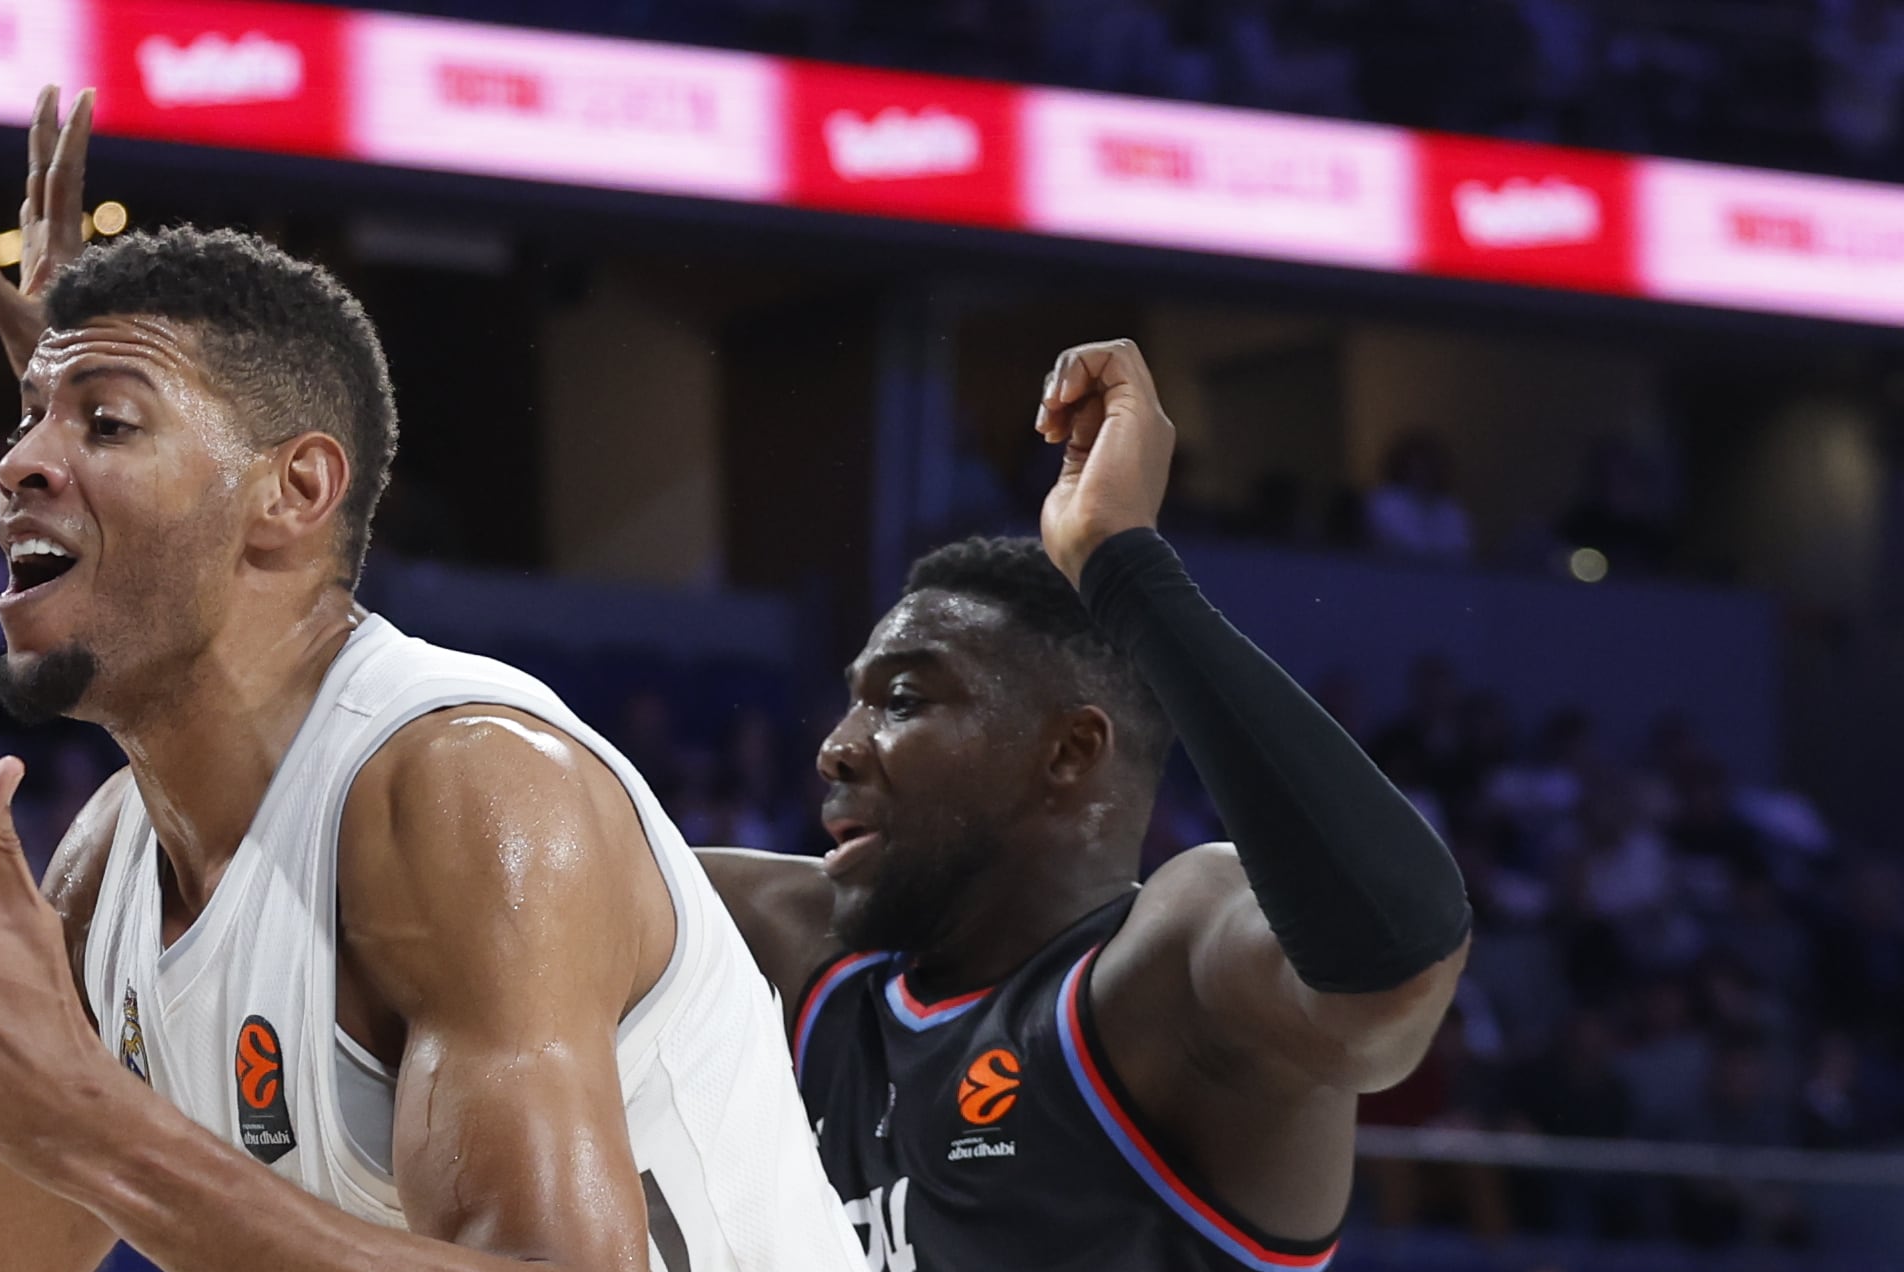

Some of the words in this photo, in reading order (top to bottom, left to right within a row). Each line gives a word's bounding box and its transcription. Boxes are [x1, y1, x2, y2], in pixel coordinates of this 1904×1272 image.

[260, 1130, 291, 1145] dhabi
[947, 1146, 973, 1161] abu
[974, 1140, 1016, 1158] dhabi
